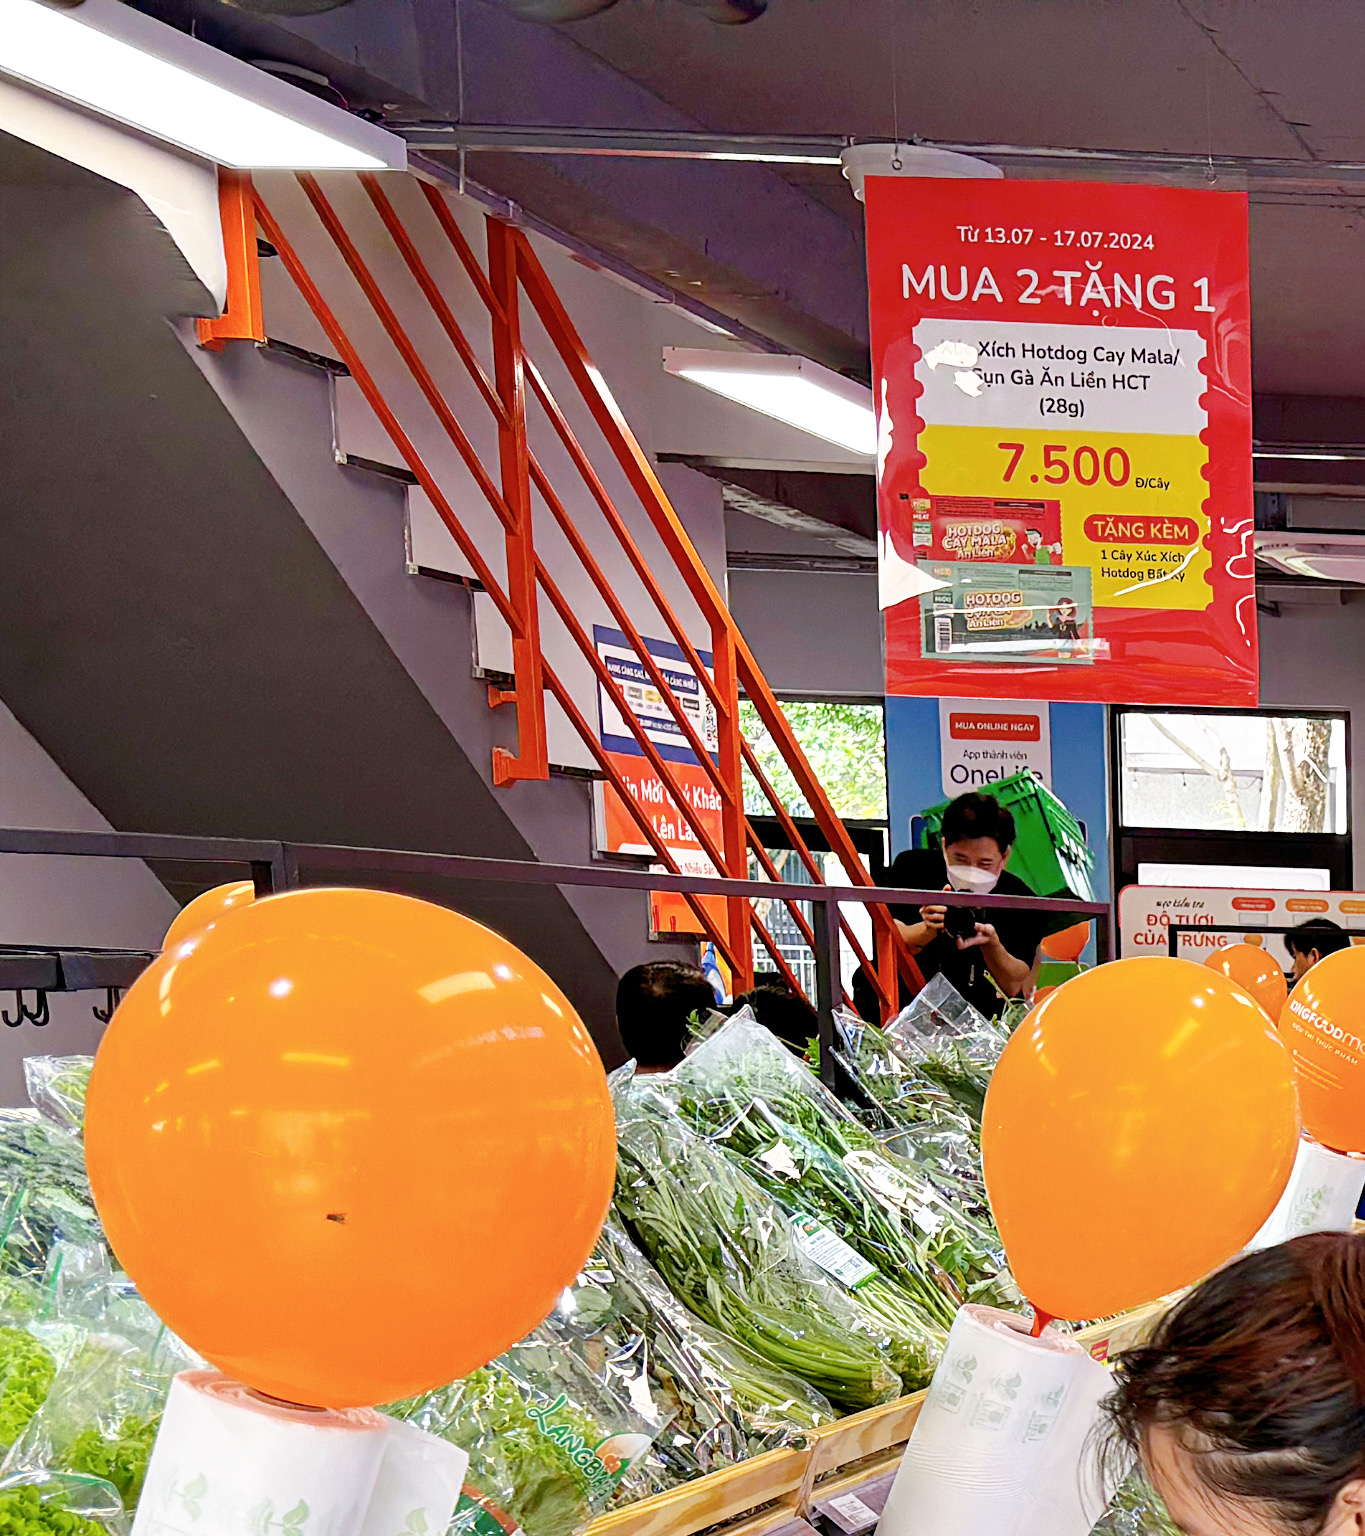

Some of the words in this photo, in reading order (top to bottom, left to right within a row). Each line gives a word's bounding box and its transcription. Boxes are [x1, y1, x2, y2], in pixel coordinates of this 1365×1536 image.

[957, 225, 980, 244] Từ
[985, 227, 1033, 245] 13.07
[1053, 231, 1155, 251] 17.07.2024
[902, 264, 1004, 303] MUA
[1018, 269, 1042, 304] 2
[1054, 260, 1176, 317] TẶNG
[1194, 277, 1216, 313] 1
[978, 341, 1016, 358] Xích
[1021, 343, 1088, 365] Hotdog
[1093, 346, 1126, 367] Cay
[1131, 348, 1180, 367] Mala/
[1010, 367, 1035, 386] Gà
[1040, 366, 1066, 387] Ăn
[1071, 369, 1107, 390] Liền
[1112, 374, 1151, 391] HCT
[1039, 398, 1085, 418] (28g)
[998, 442, 1131, 487] 7.500
[1135, 476, 1170, 492] Đ/Cây
[1093, 520, 1146, 540] TẶNG
[1151, 520, 1189, 540] KÈM
[1101, 550, 1107, 561] 1
[1111, 550, 1132, 564] Cây
[1136, 550, 1156, 563] Xúc
[1160, 551, 1185, 565] Xích
[954, 720, 978, 731] MUA
[981, 721, 1008, 732] ONLINE
[1011, 722, 1035, 732] NGAY
[963, 750, 979, 762] App
[1006, 750, 1027, 761] viên
